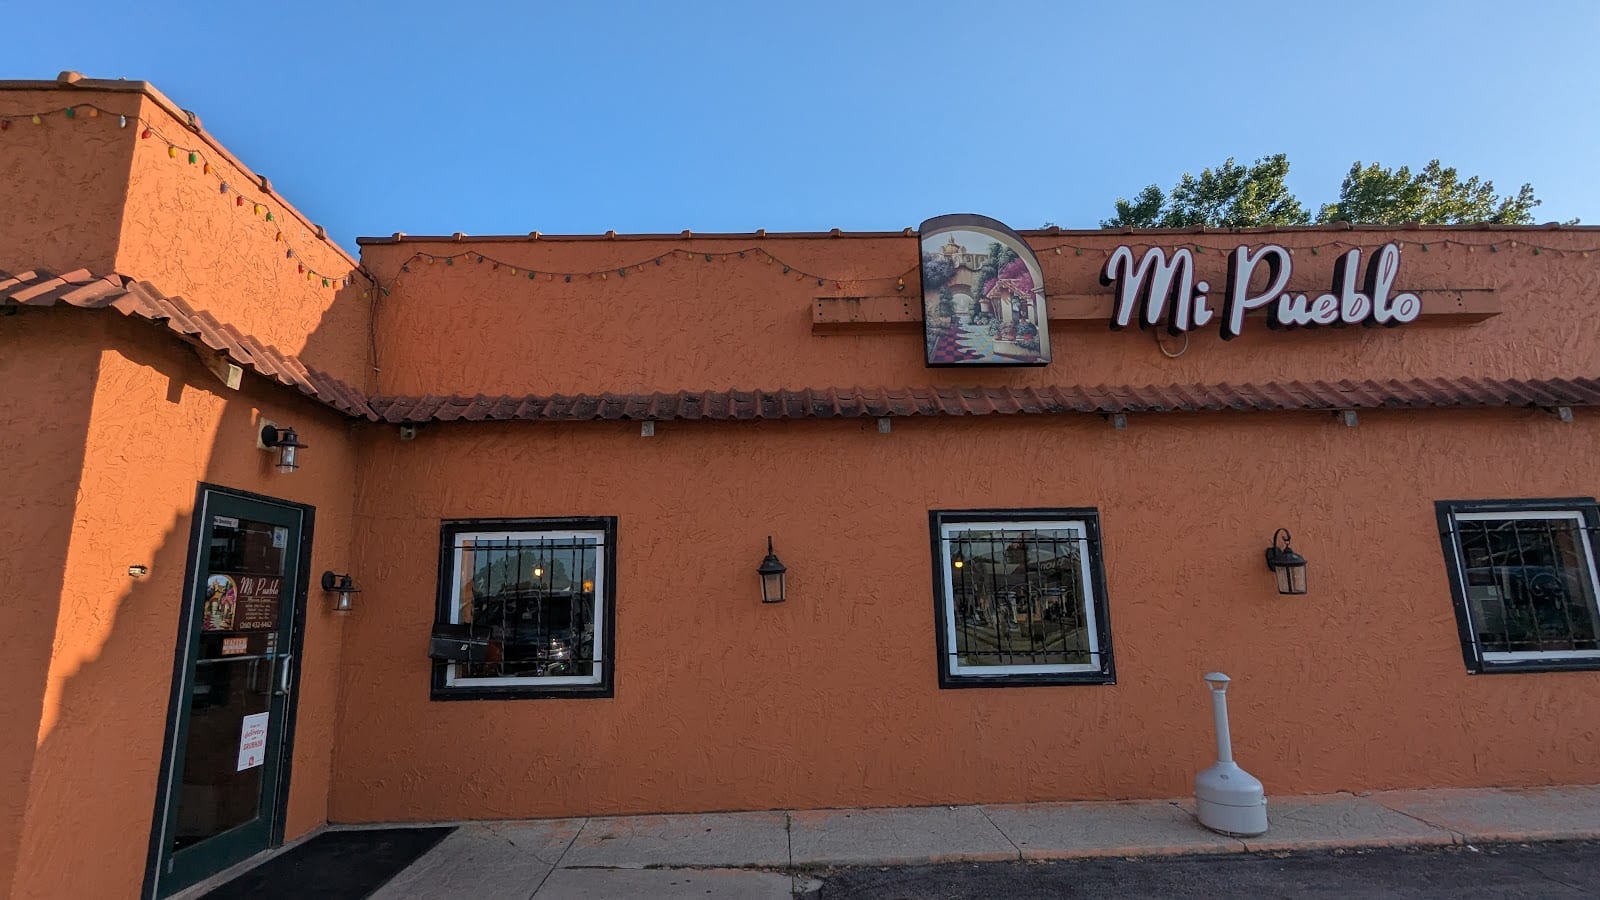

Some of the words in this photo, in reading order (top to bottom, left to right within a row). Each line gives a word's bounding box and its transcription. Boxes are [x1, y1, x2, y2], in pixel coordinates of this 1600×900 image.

[1102, 245, 1213, 332] Mi
[1228, 243, 1422, 336] Pueblo
[240, 577, 253, 594] Mi
[256, 578, 279, 595] Pueblo
